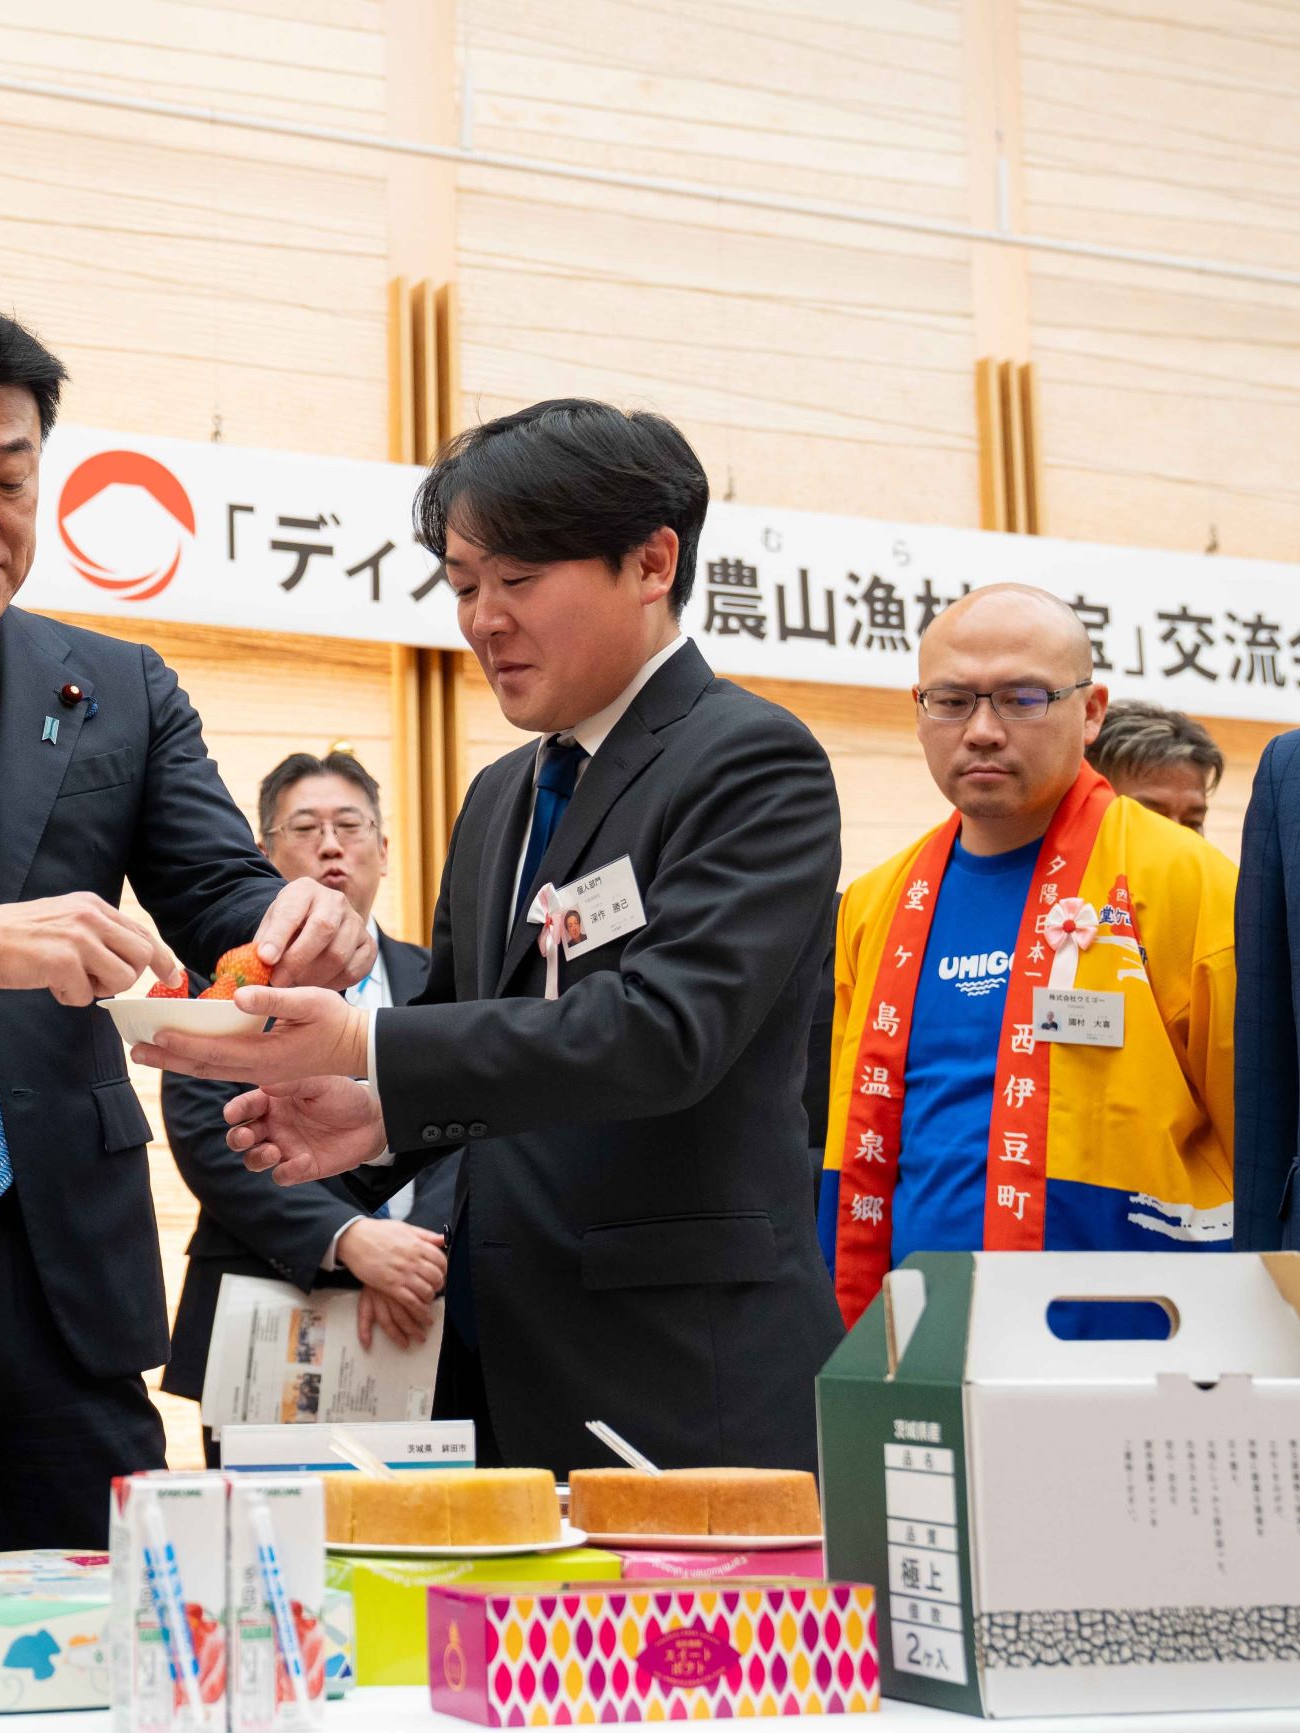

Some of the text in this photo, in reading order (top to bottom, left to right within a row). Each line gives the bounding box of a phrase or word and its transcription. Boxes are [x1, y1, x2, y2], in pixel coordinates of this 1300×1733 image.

[1049, 993, 1106, 1004] 株式会社ウミゴー
[996, 1023, 1036, 1221] 西伊豆町
[407, 1443, 468, 1454] 茨城県 鉾田市
[901, 1557, 943, 1593] 極上
